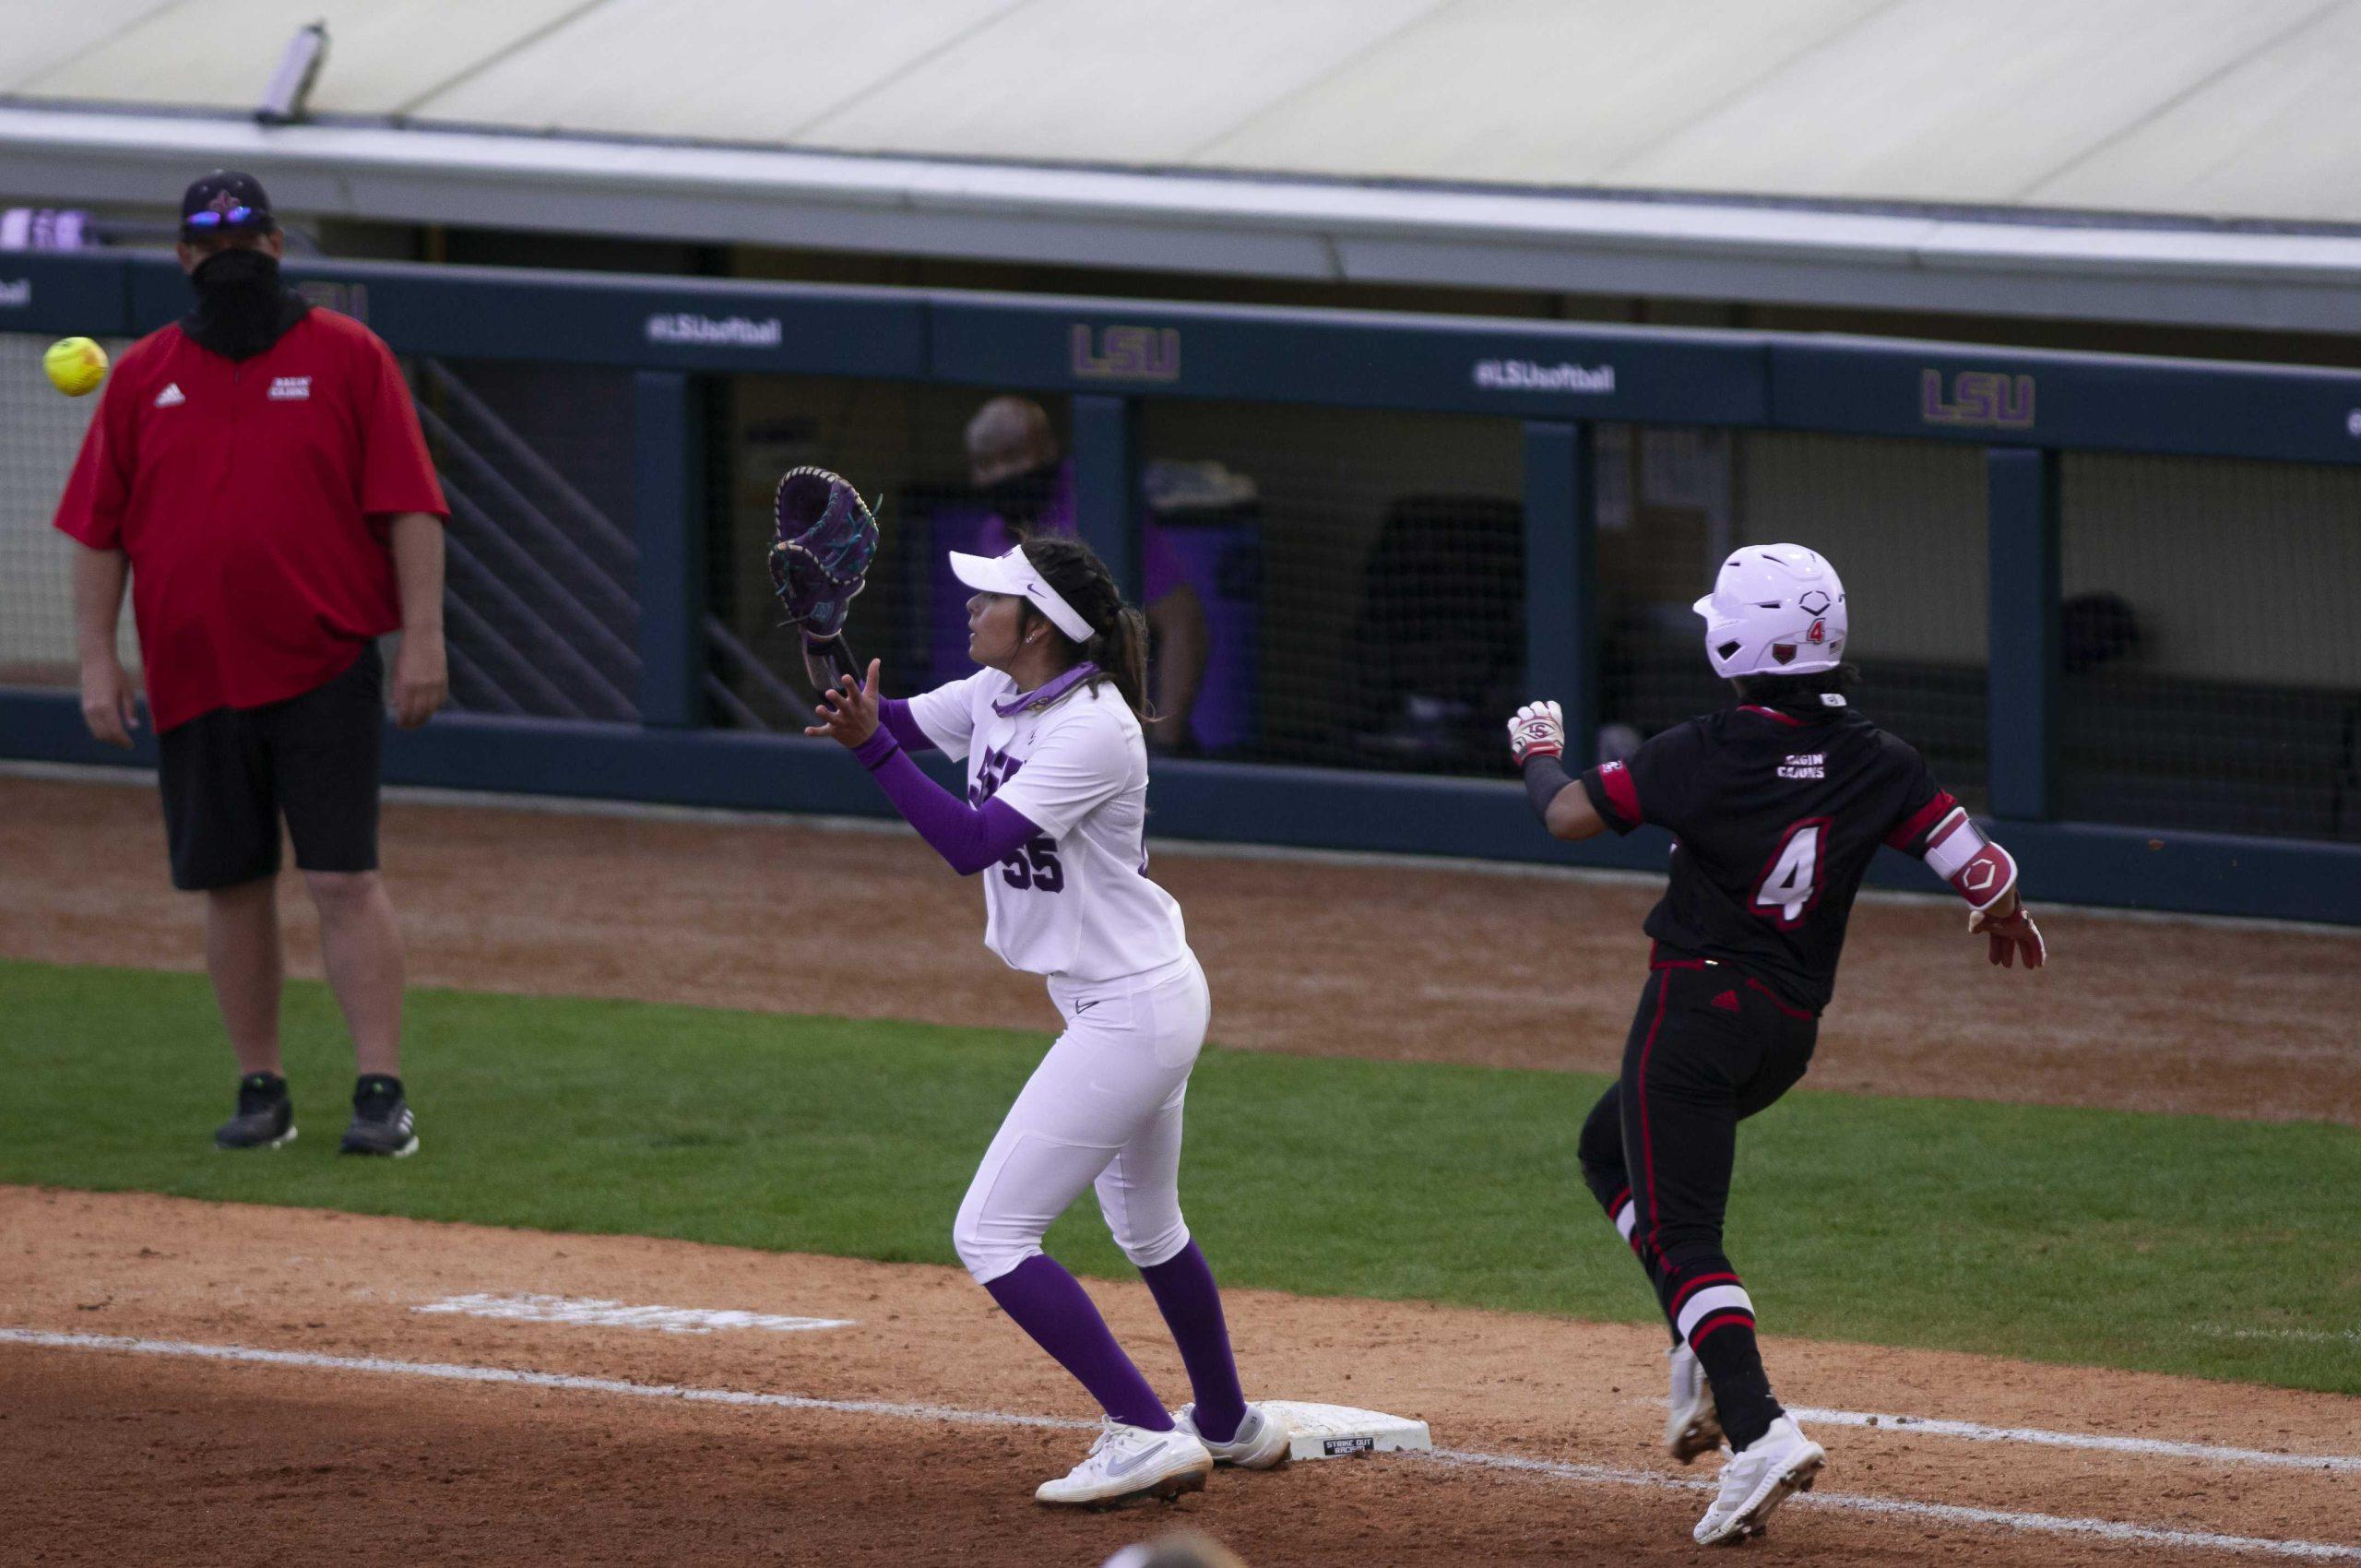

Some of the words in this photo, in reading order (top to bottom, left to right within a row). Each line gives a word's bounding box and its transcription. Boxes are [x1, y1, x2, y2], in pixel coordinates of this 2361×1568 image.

[1071, 323, 1180, 381] LSU
[1921, 368, 2035, 428] LSU
[1806, 617, 1826, 645] 4
[1002, 837, 1065, 894] 55
[1750, 817, 1831, 929] 4
[1326, 1439, 1355, 1449] STRIKE
[1356, 1438, 1372, 1446] OUT
